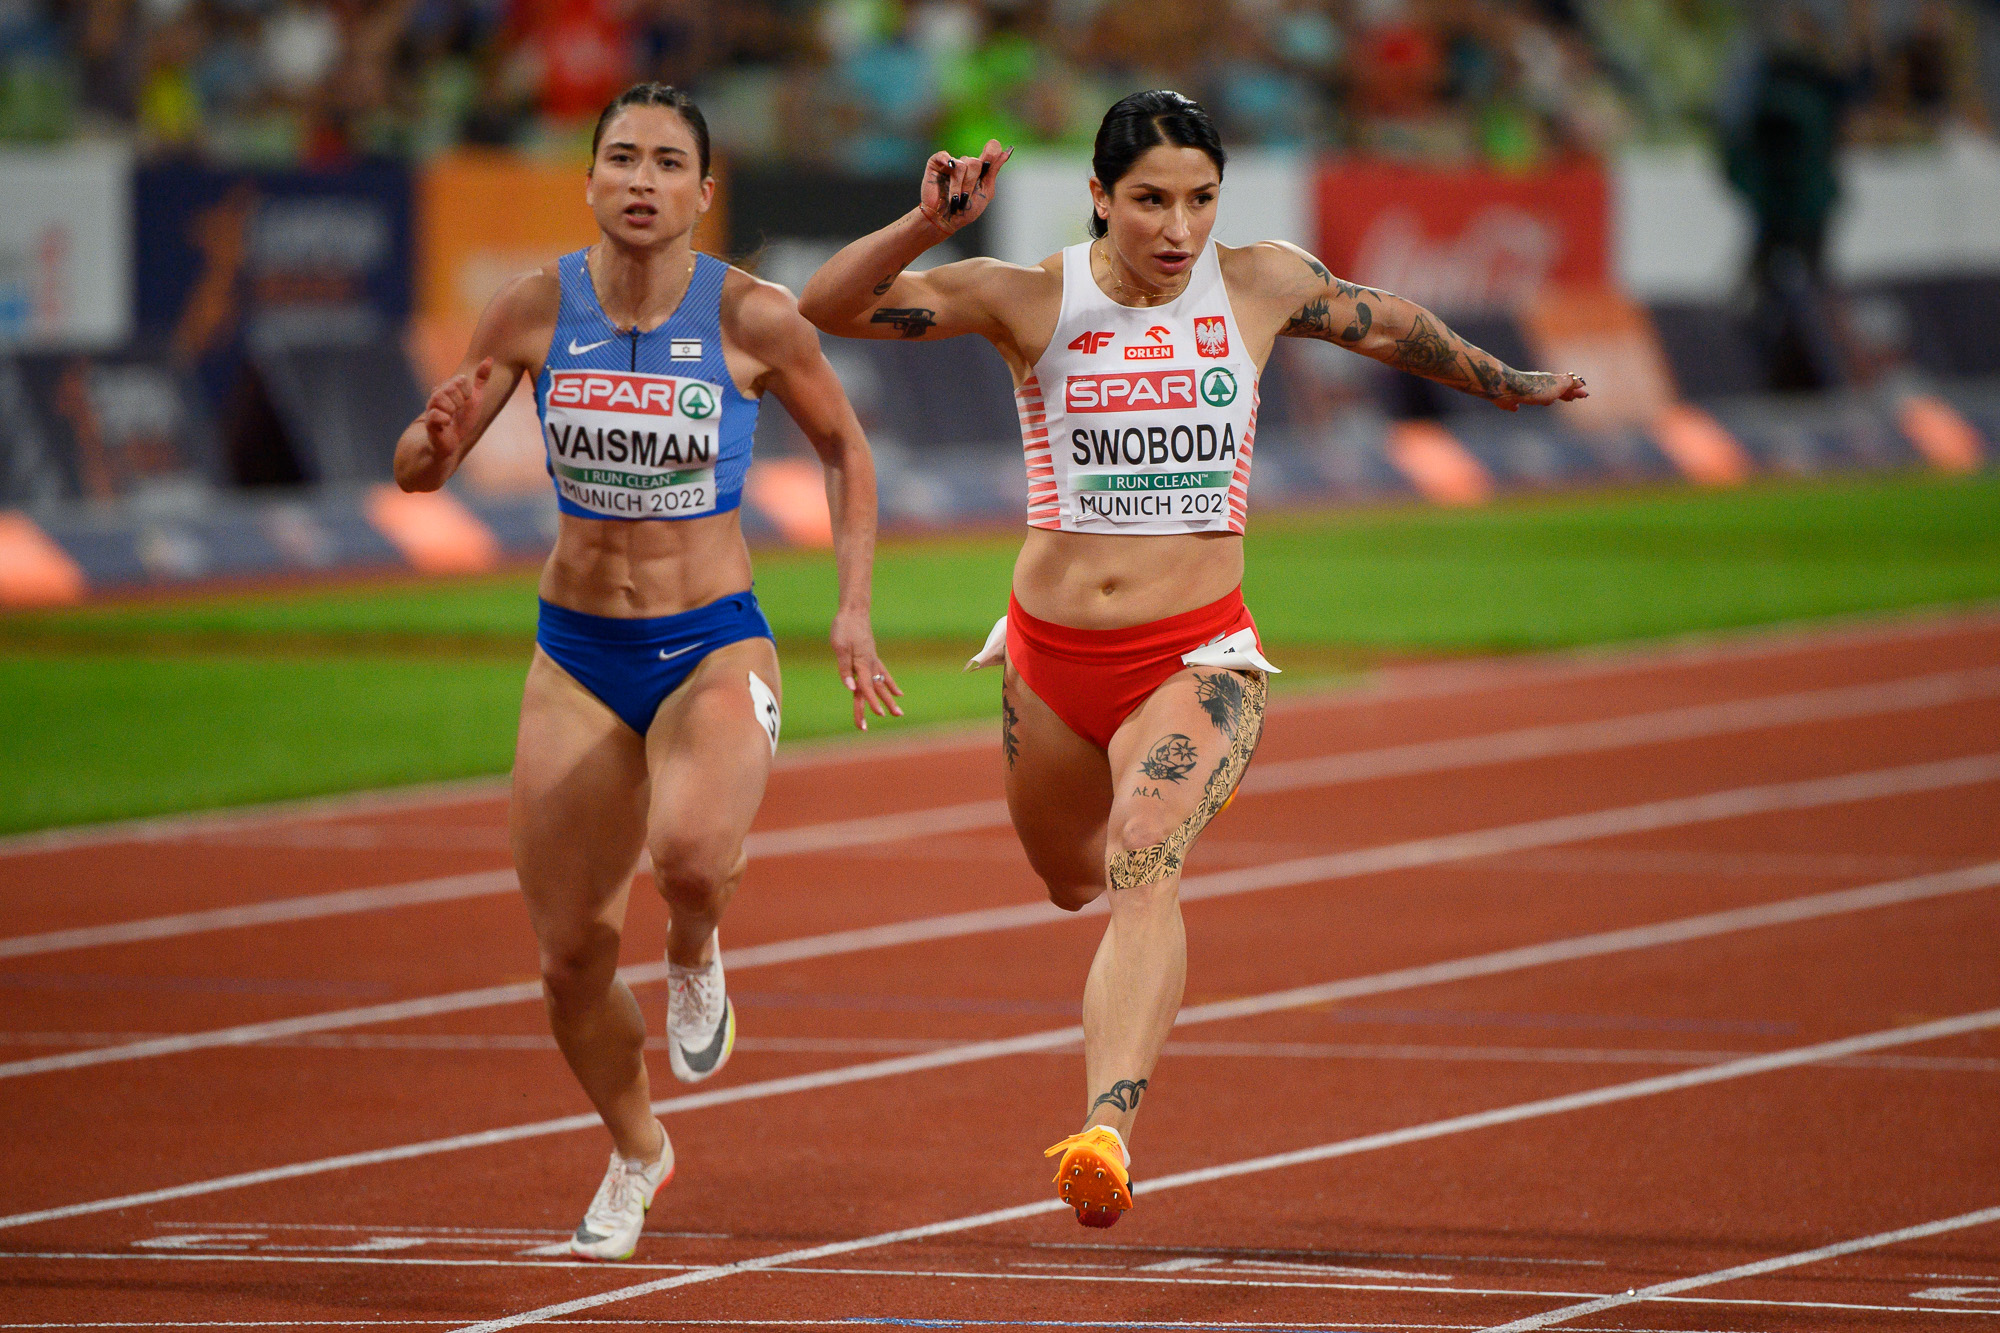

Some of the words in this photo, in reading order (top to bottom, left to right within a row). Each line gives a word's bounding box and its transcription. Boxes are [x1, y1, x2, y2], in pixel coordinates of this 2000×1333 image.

[1067, 330, 1116, 355] 4F
[1126, 346, 1171, 359] ORLEN
[552, 377, 672, 411] SPAR
[1069, 375, 1193, 408] SPAR
[549, 422, 710, 467] VAISMAN
[1071, 422, 1236, 466] SWOBODA
[584, 471, 589, 482] I
[592, 471, 623, 485] RUN
[1108, 476, 1112, 489] I
[1116, 475, 1150, 489] RUN
[563, 480, 642, 512] MUNICH
[651, 487, 705, 512] 2022
[1079, 495, 1171, 516] MUNICH
[1181, 493, 1228, 514] 202
